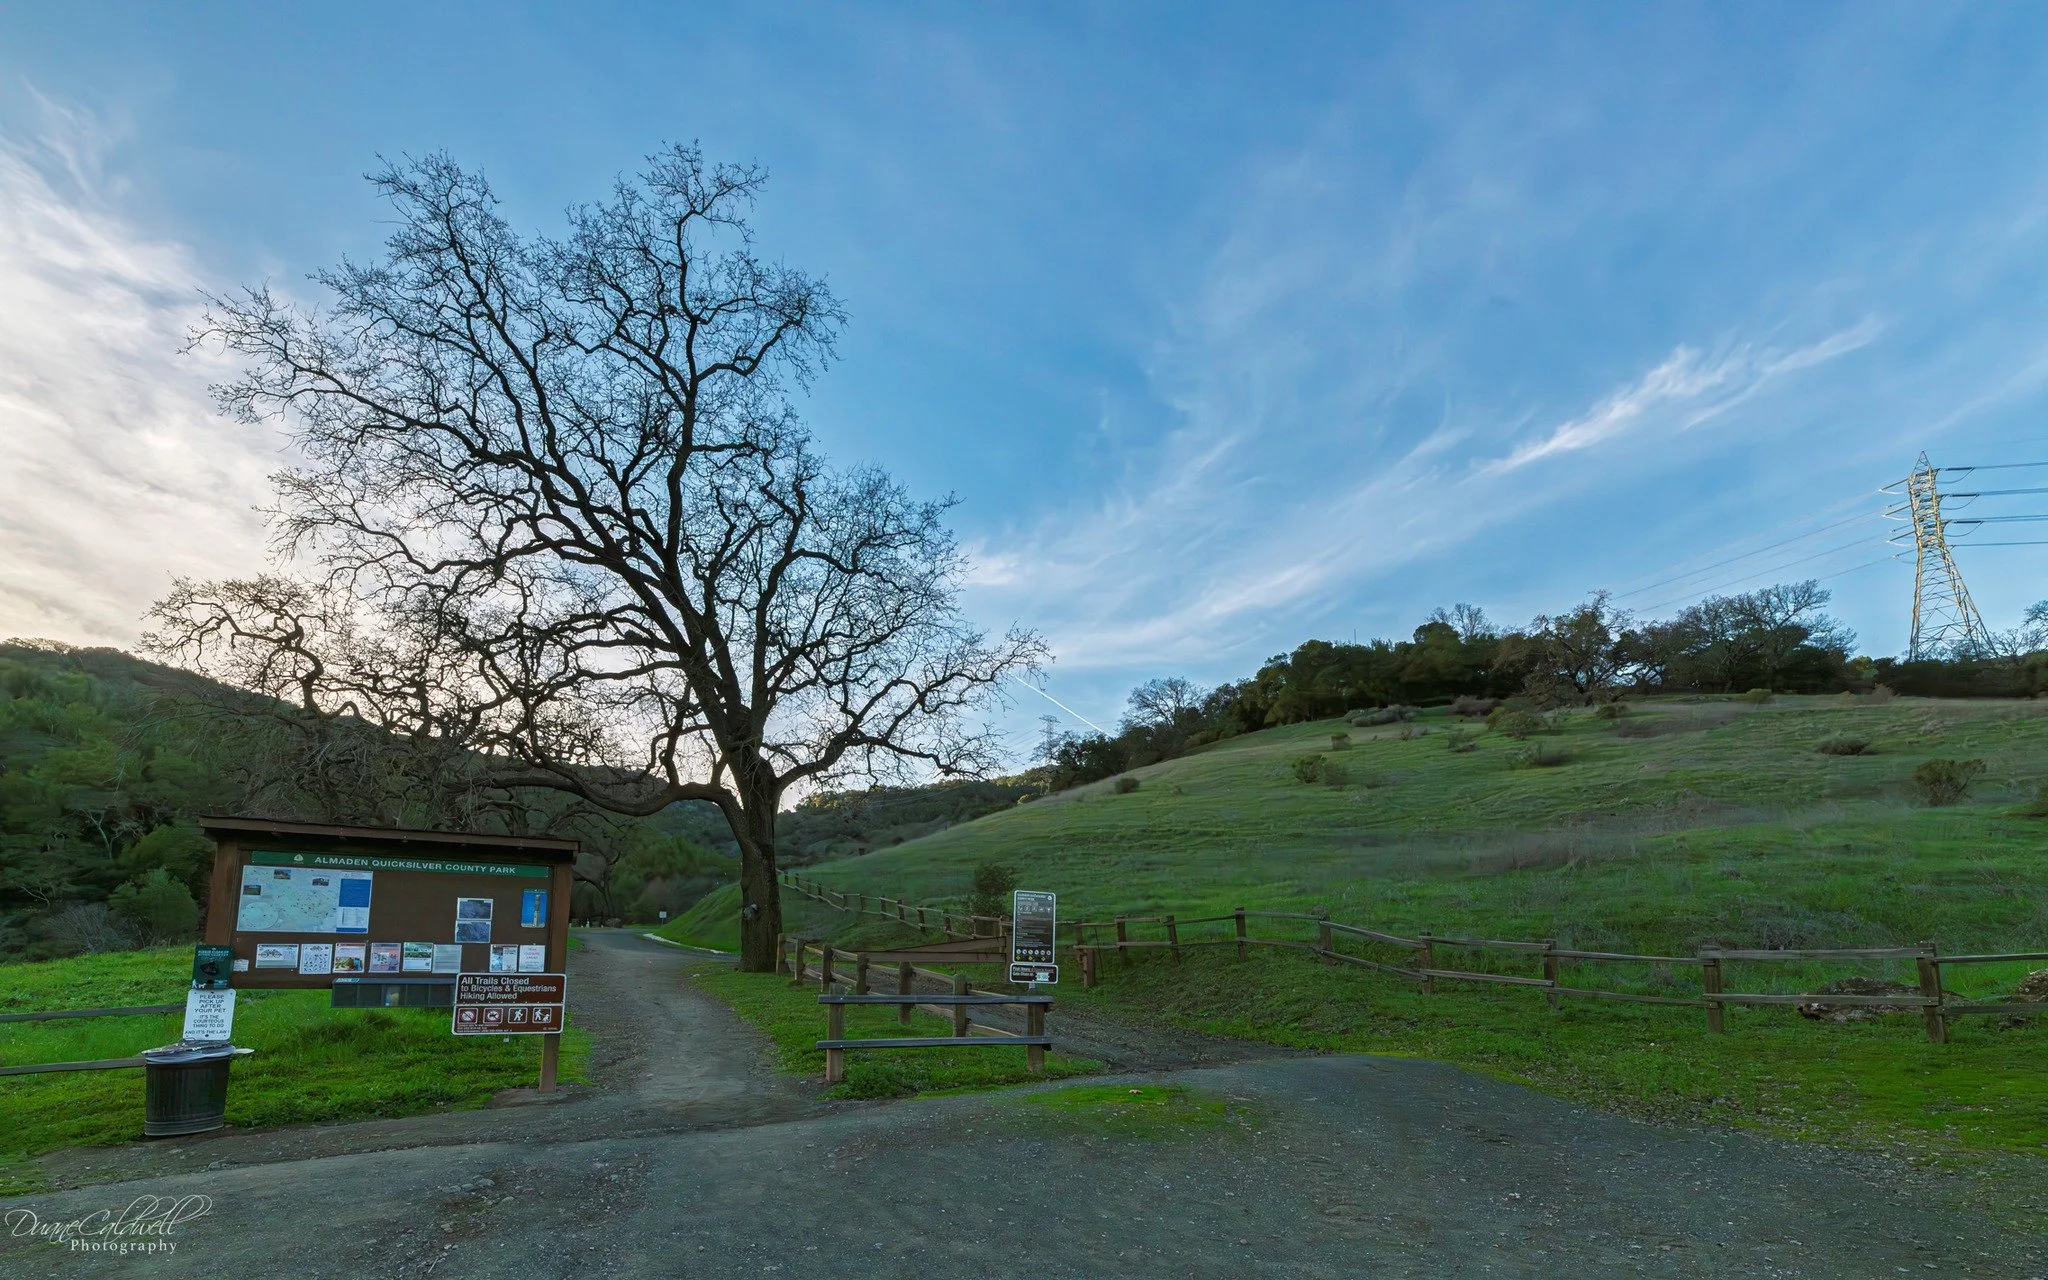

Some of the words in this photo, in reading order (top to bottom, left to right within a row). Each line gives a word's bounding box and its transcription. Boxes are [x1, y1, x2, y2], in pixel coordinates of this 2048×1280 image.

[314, 856, 368, 866] ALMADEN
[371, 859, 442, 870] QUICKSILVER
[445, 863, 487, 873] COUNTY
[489, 866, 516, 874] PARK
[461, 976, 473, 985] All
[475, 976, 498, 985] Trails
[500, 977, 530, 985] Closed
[470, 984, 503, 992] Bicycles
[512, 984, 557, 993] Equestrians
[460, 992, 485, 1001] Hiking
